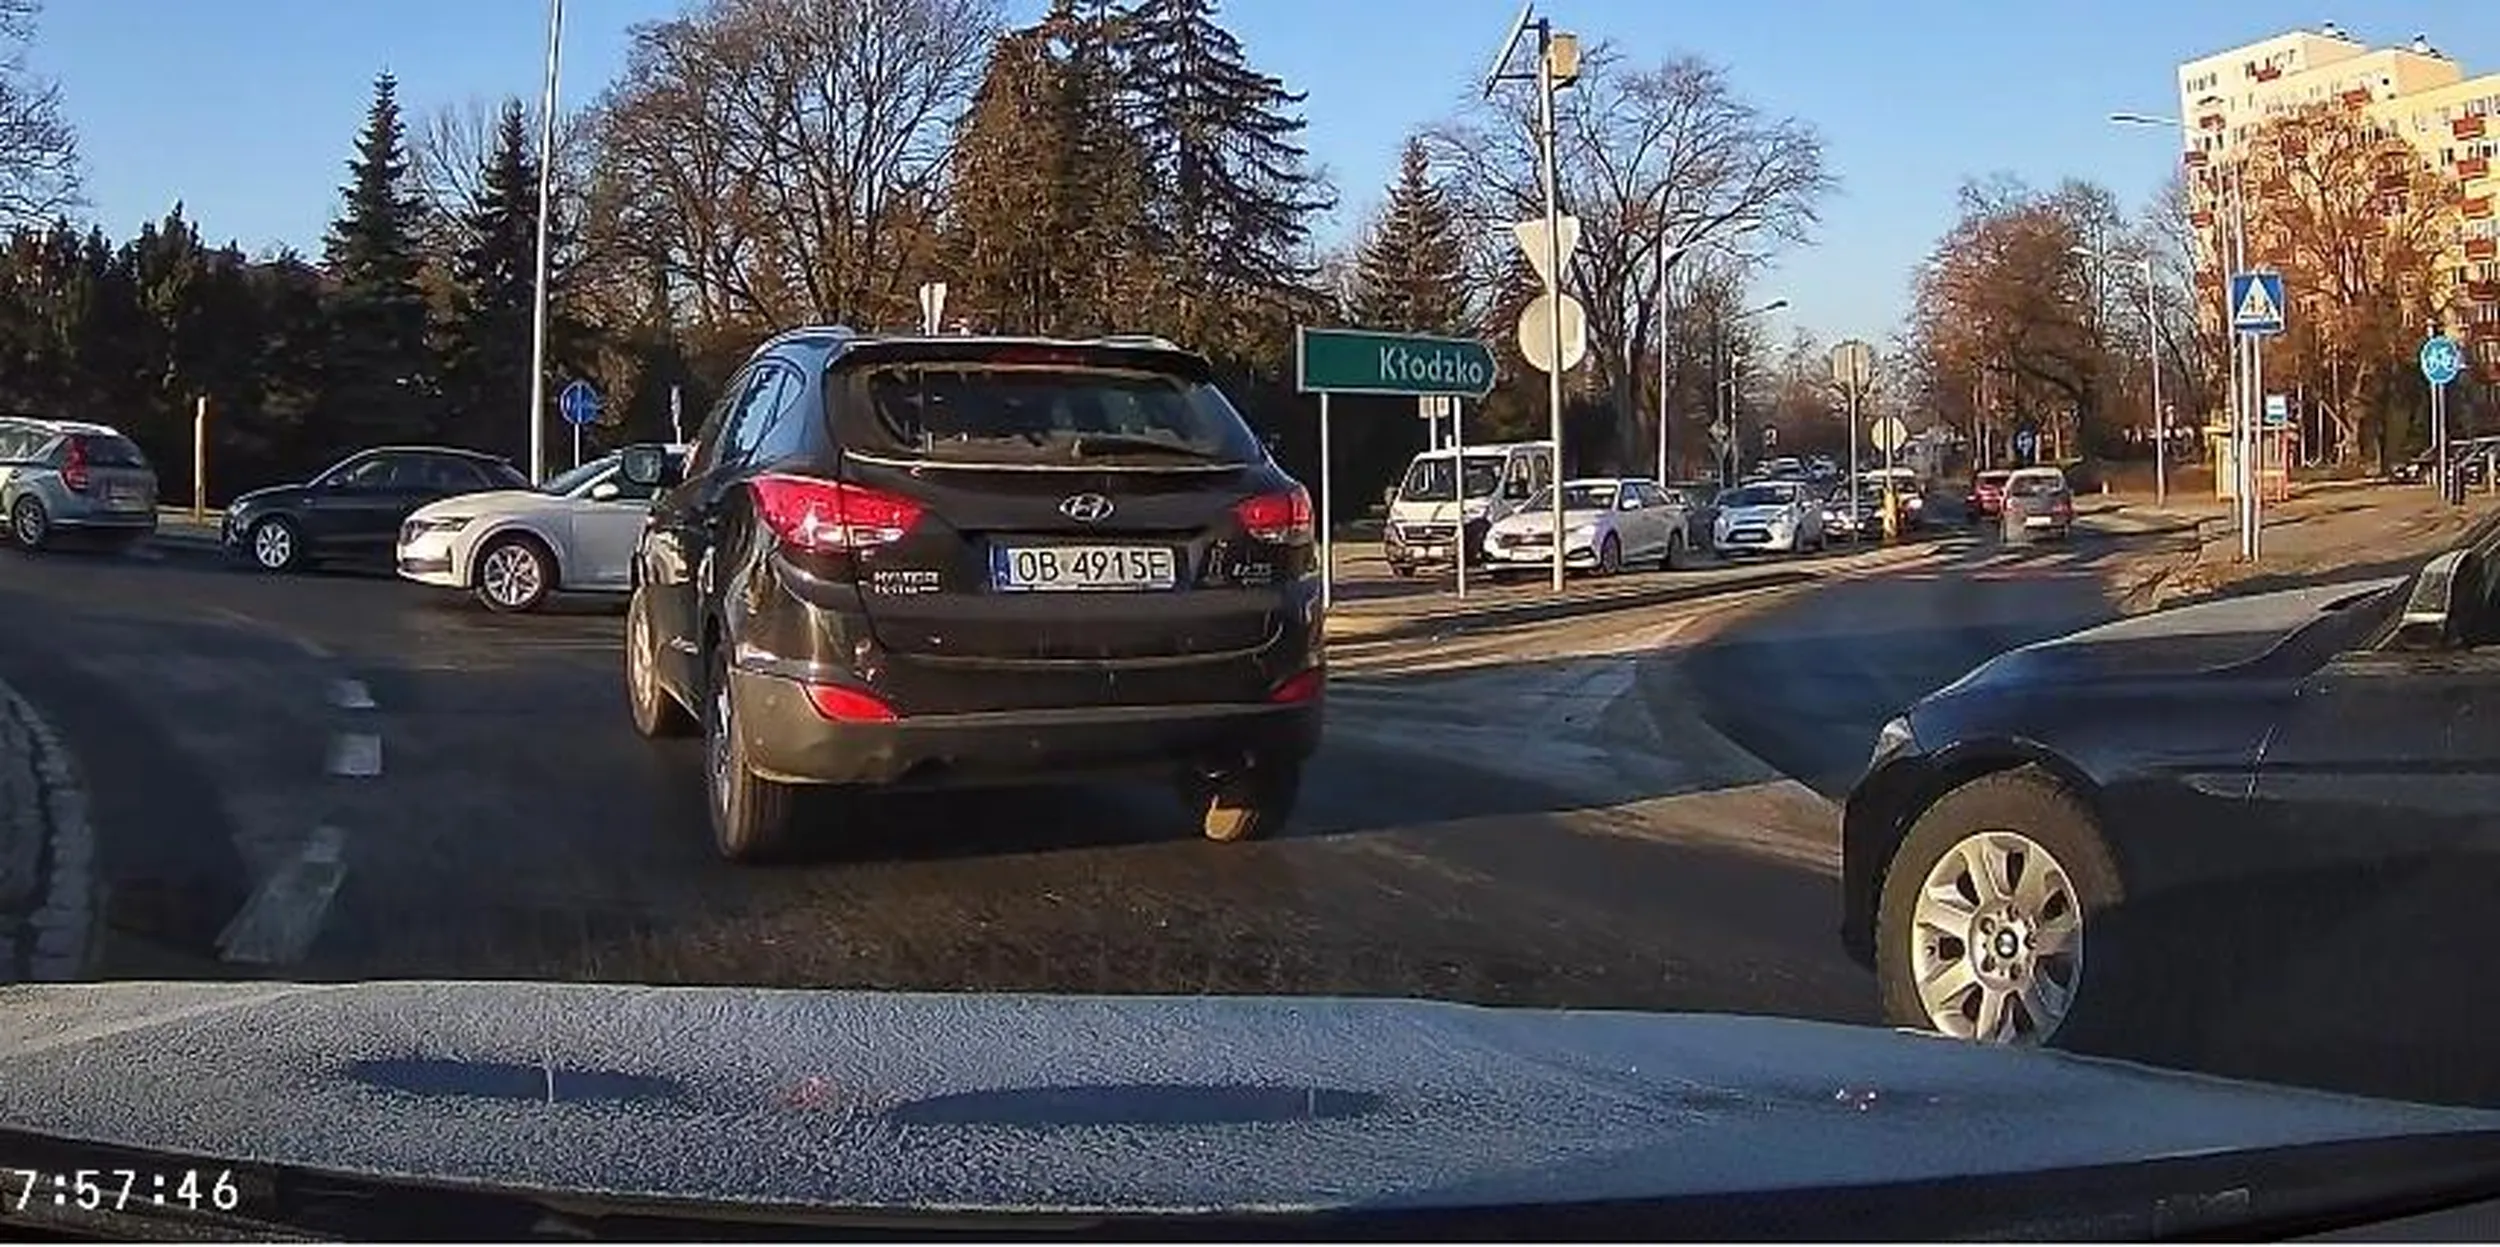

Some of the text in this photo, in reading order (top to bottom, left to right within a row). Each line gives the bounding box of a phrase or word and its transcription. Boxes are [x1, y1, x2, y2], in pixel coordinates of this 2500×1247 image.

[1379, 345, 1485, 384] Kłodzko
[1017, 550, 1173, 582] OB 4915E
